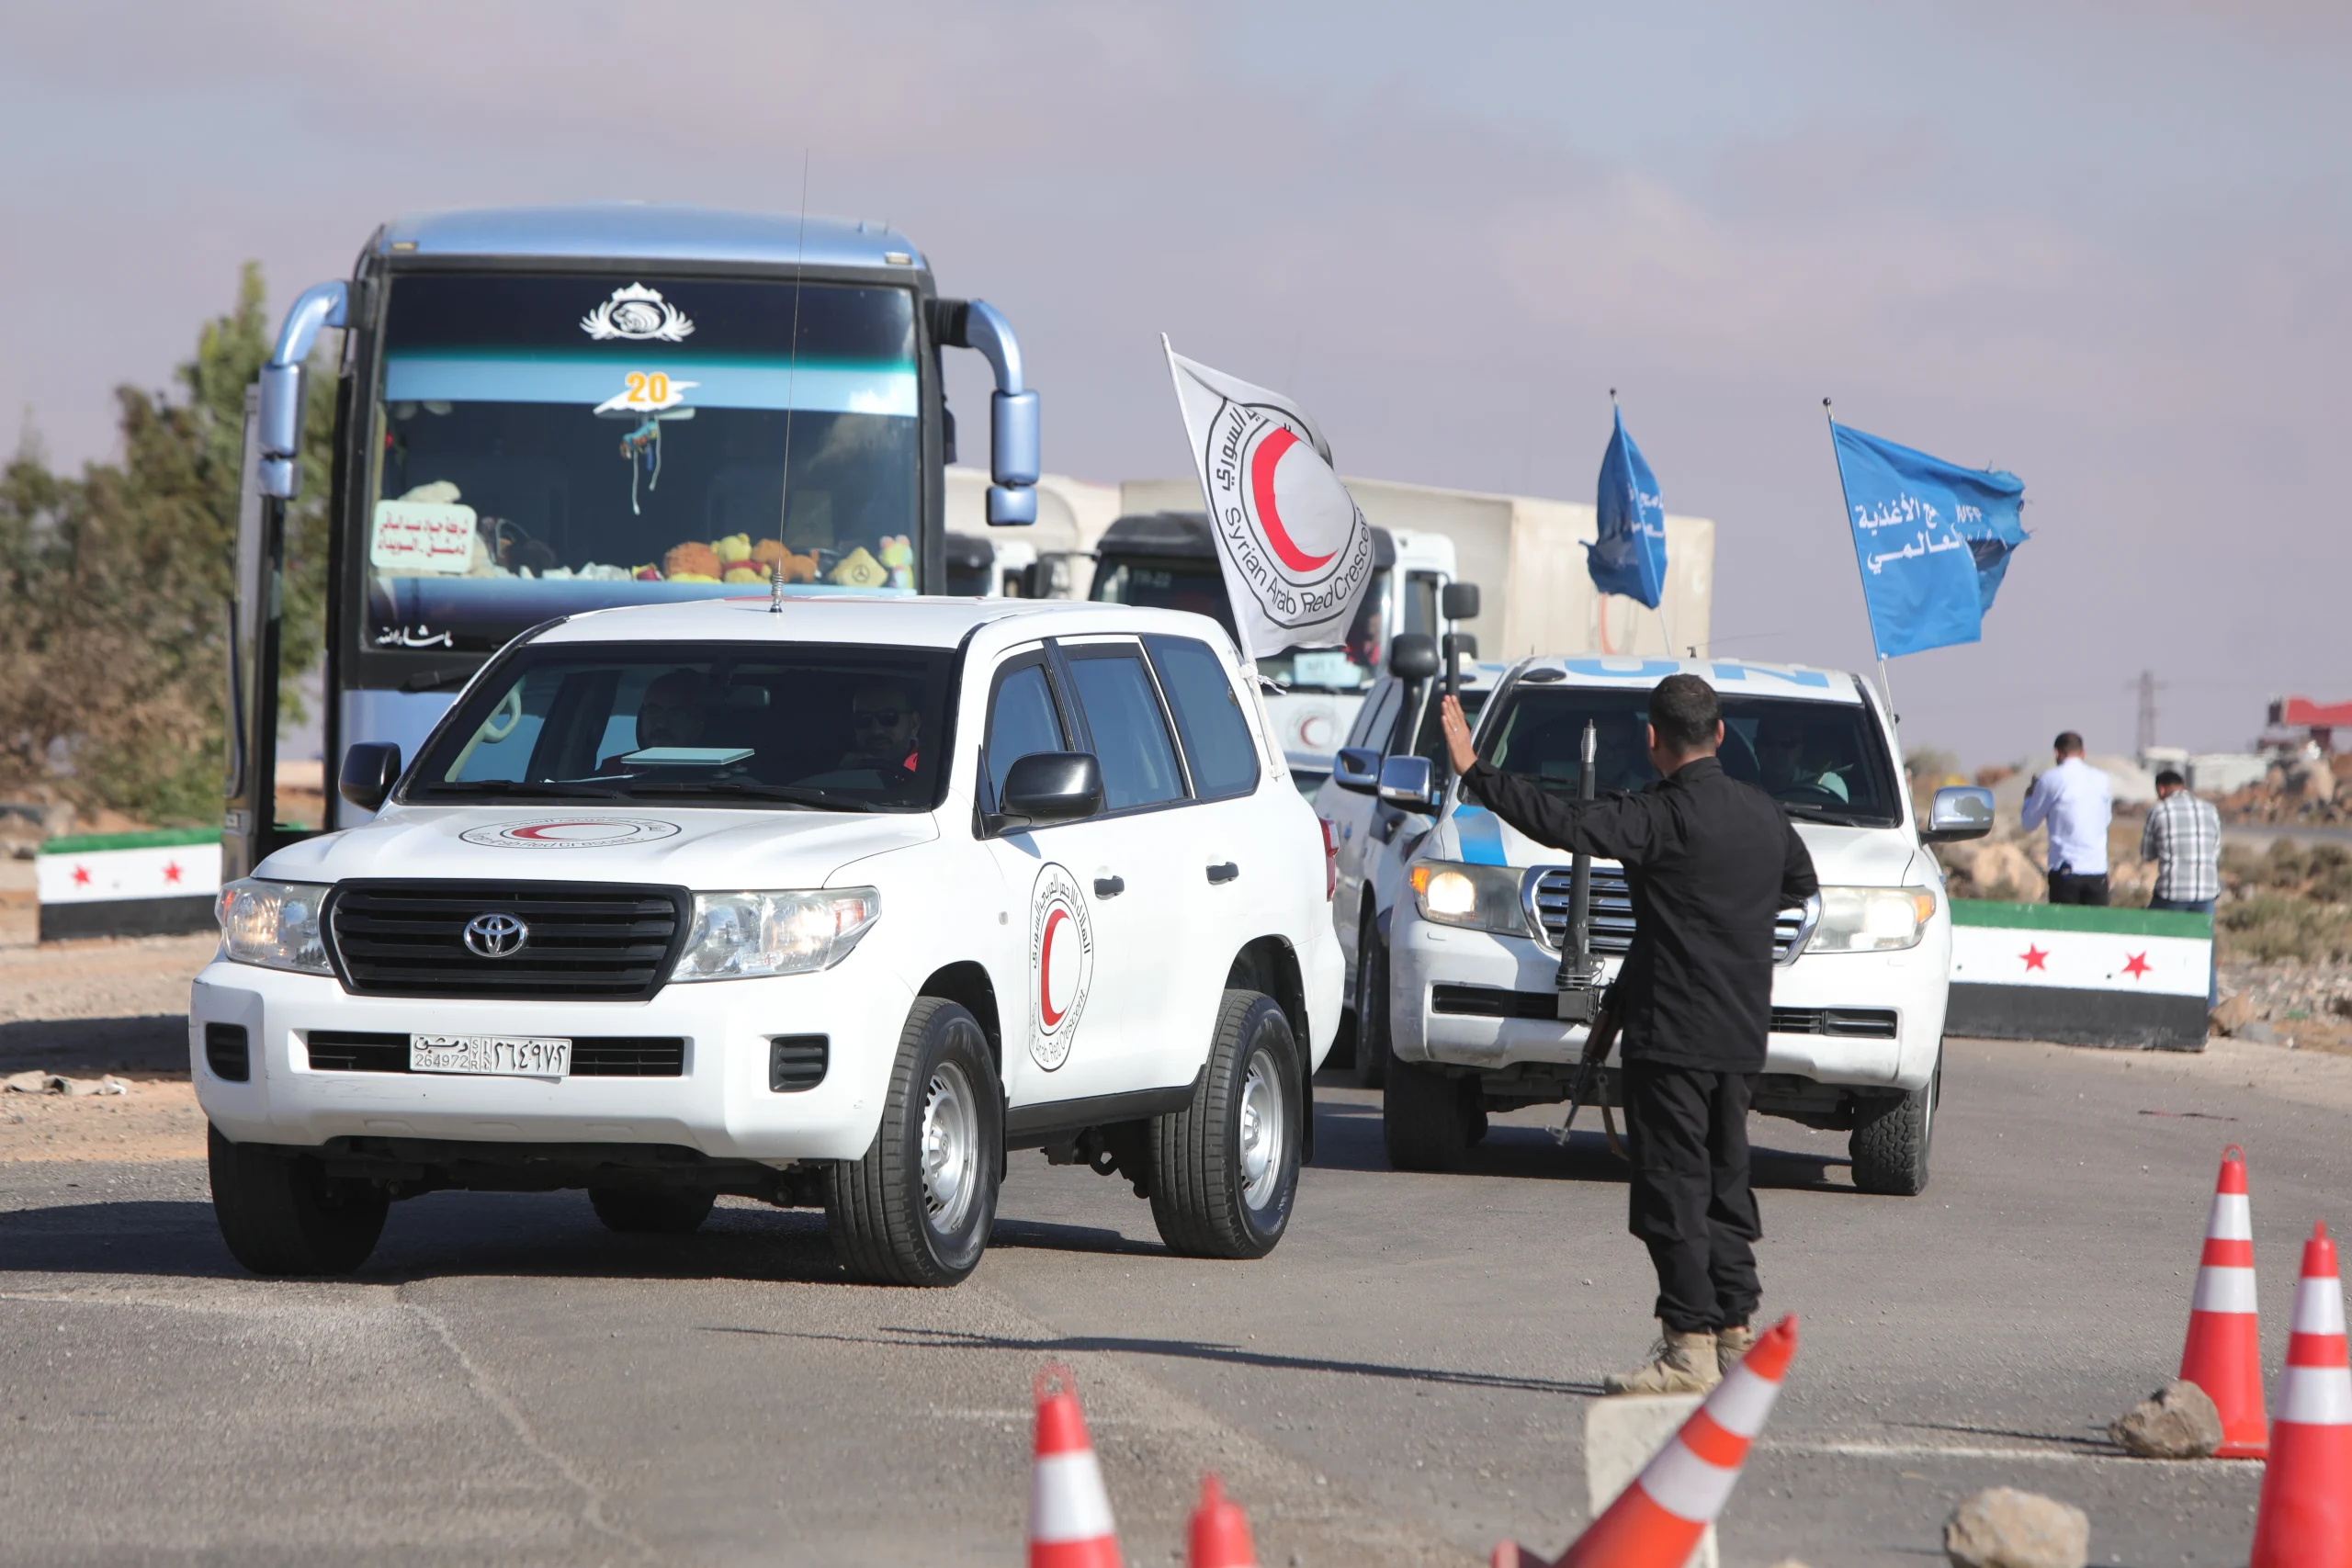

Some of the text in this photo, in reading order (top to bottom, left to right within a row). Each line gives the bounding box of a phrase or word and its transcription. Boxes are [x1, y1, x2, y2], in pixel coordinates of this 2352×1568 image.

[627, 372, 667, 402] 20
[1855, 492, 1920, 536] الأغذية
[1226, 507, 1268, 587] Syrian
[1267, 578, 1296, 615] Arab
[1300, 586, 1333, 615] Red
[1564, 659, 1830, 689] UN
[1049, 1036, 1062, 1063] Red
[1059, 988, 1086, 1050] Crescent
[414, 1036, 469, 1053] دمشق
[470, 1039, 479, 1070] SYR
[494, 1041, 567, 1073] ٢٦٤٩٧٢
[415, 1053, 469, 1068] 264972
